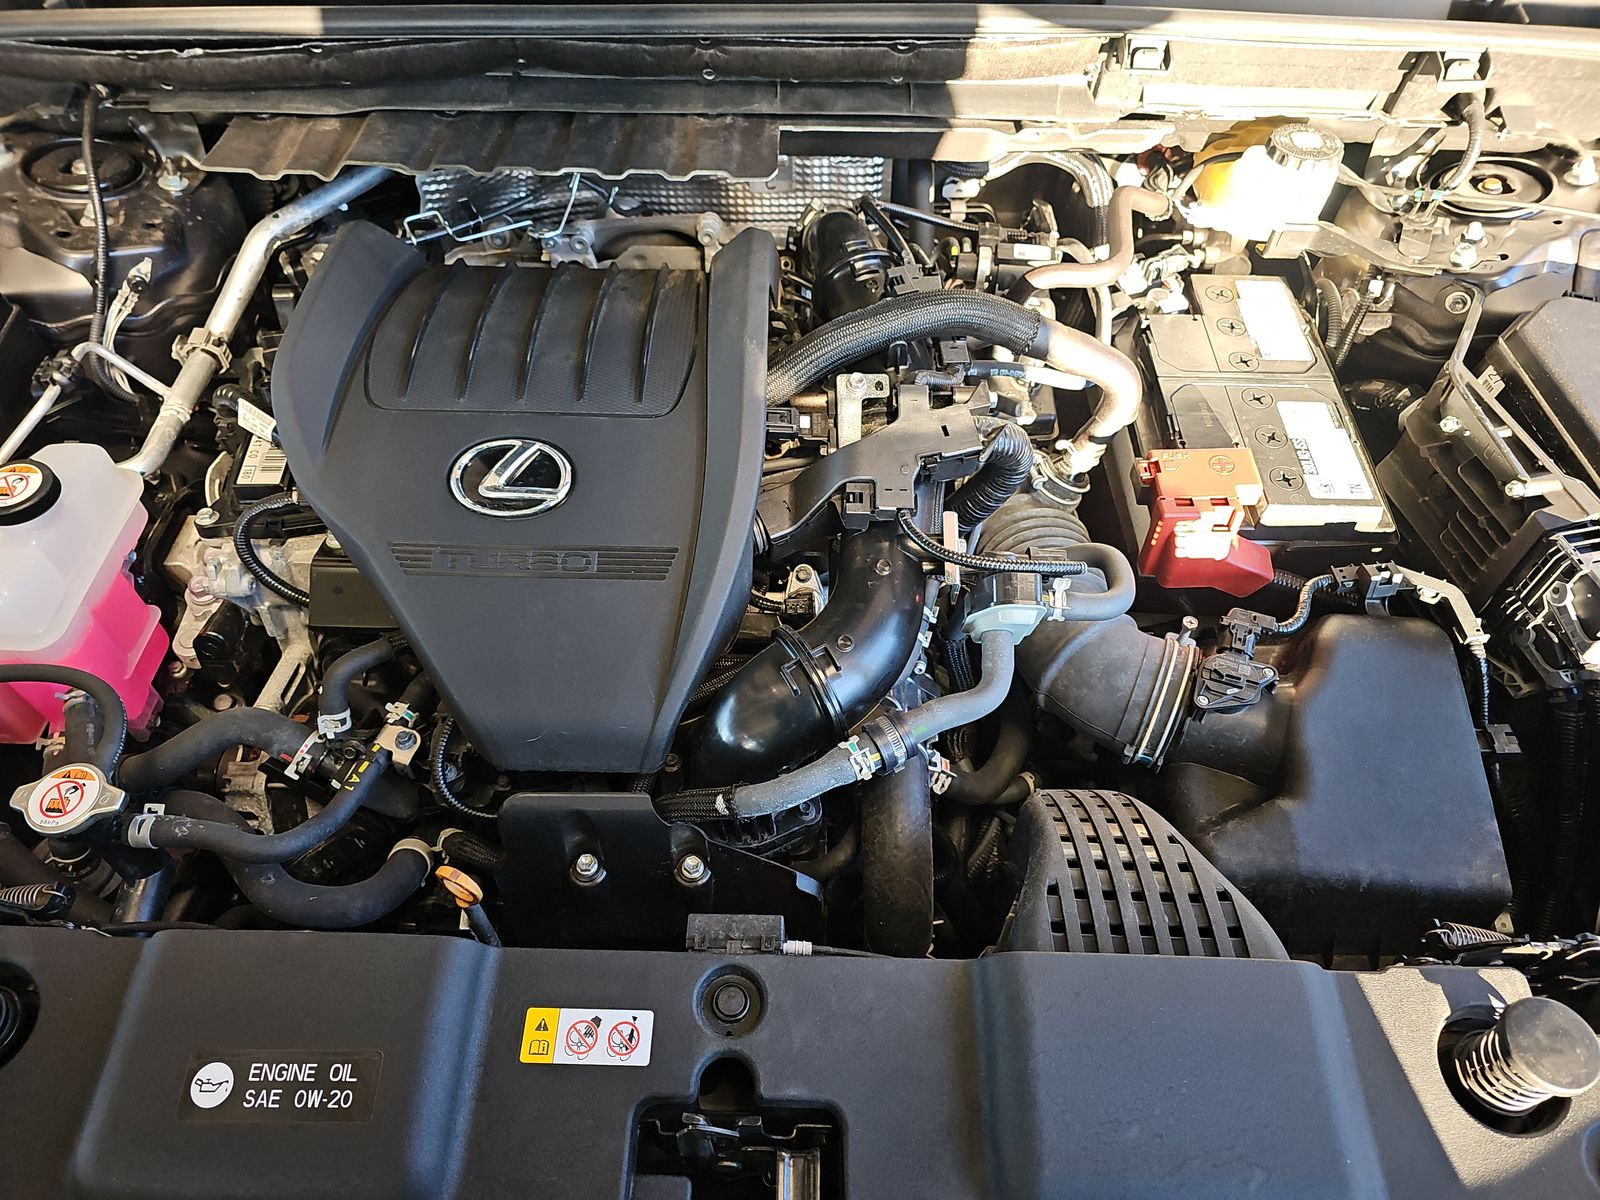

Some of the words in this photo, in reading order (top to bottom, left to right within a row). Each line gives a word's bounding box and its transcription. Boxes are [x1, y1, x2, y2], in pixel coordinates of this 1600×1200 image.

[438, 549, 596, 572] TURBO
[248, 1063, 318, 1082] ENGINE
[329, 1063, 358, 1082] OIL
[242, 1090, 283, 1108] SAE
[294, 1090, 353, 1108] 0W-20
